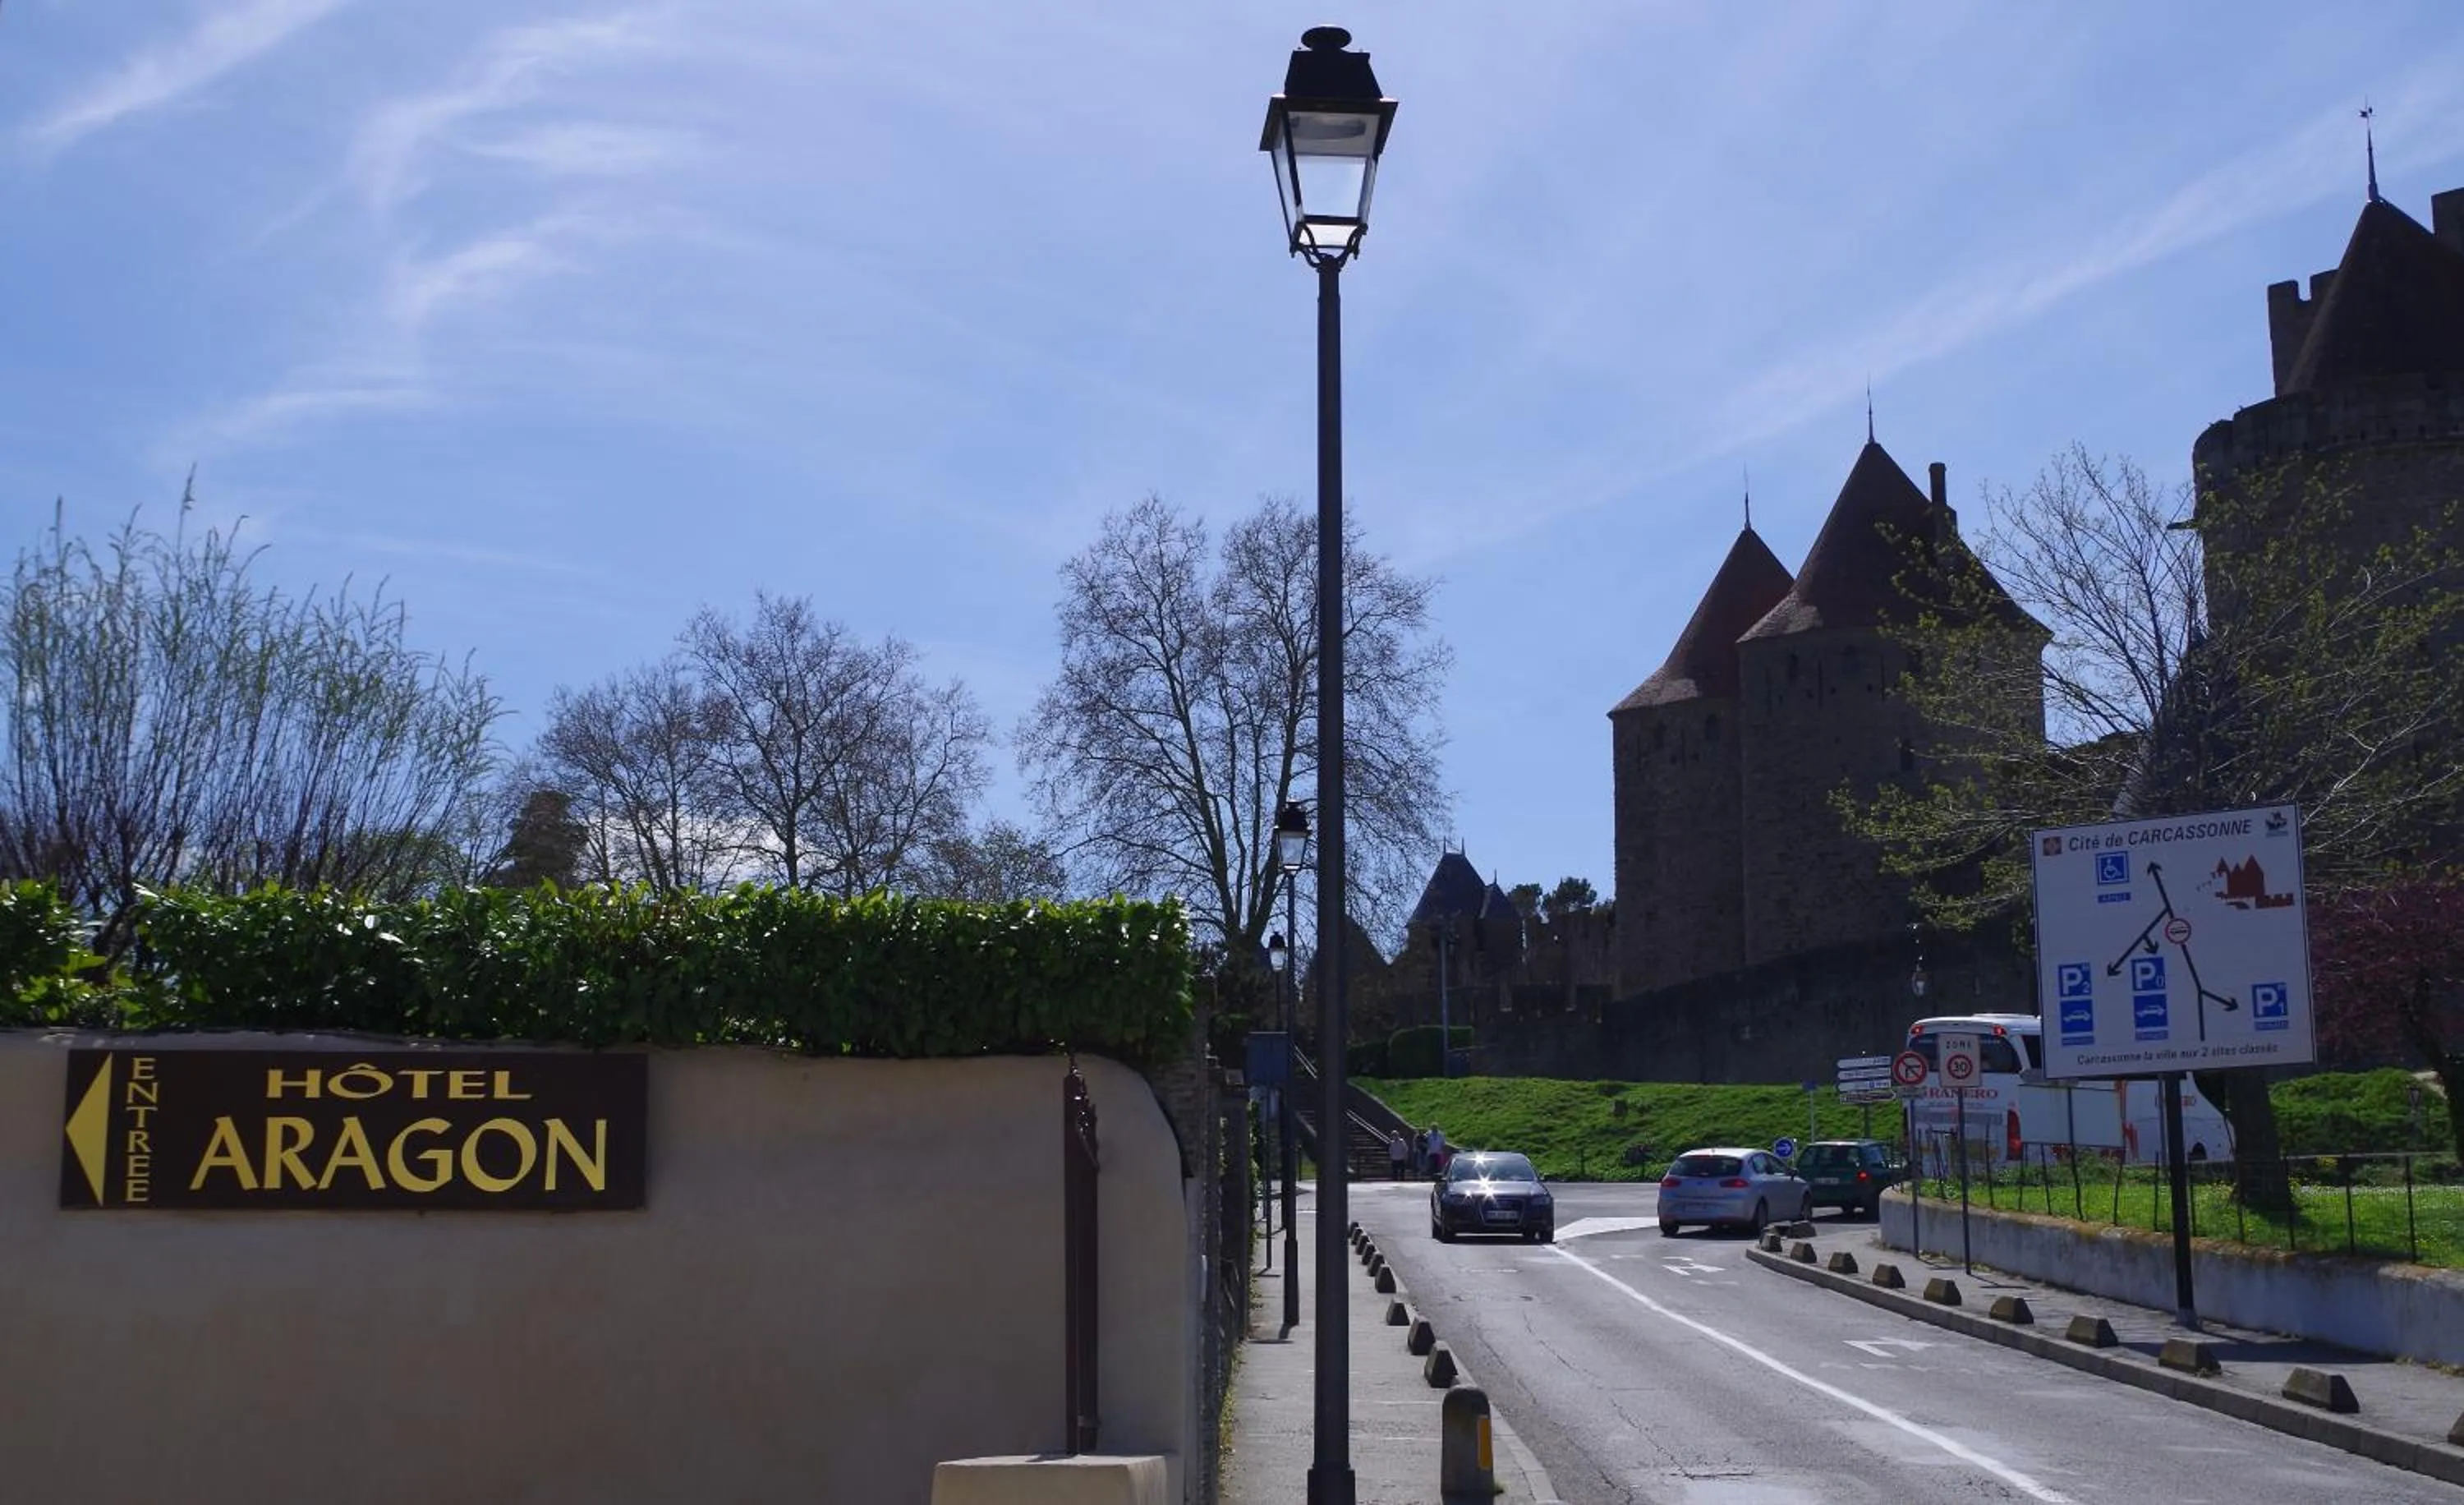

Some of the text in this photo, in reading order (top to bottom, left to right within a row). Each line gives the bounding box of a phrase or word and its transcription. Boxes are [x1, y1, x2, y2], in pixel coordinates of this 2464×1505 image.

[2068, 819, 2252, 852] Cité de CARCASSONNE
[1946, 1040, 1971, 1050] ZONE
[2077, 1051, 2141, 1065] Carcassonne
[2144, 1050, 2153, 1061] la
[2156, 1048, 2177, 1060] ville
[2201, 1047, 2209, 1057] 2
[265, 1062, 533, 1099] HÔTEL
[1953, 1061, 1967, 1072] 30
[124, 1056, 159, 1204] ENTREE
[189, 1116, 608, 1193] ARAGON
